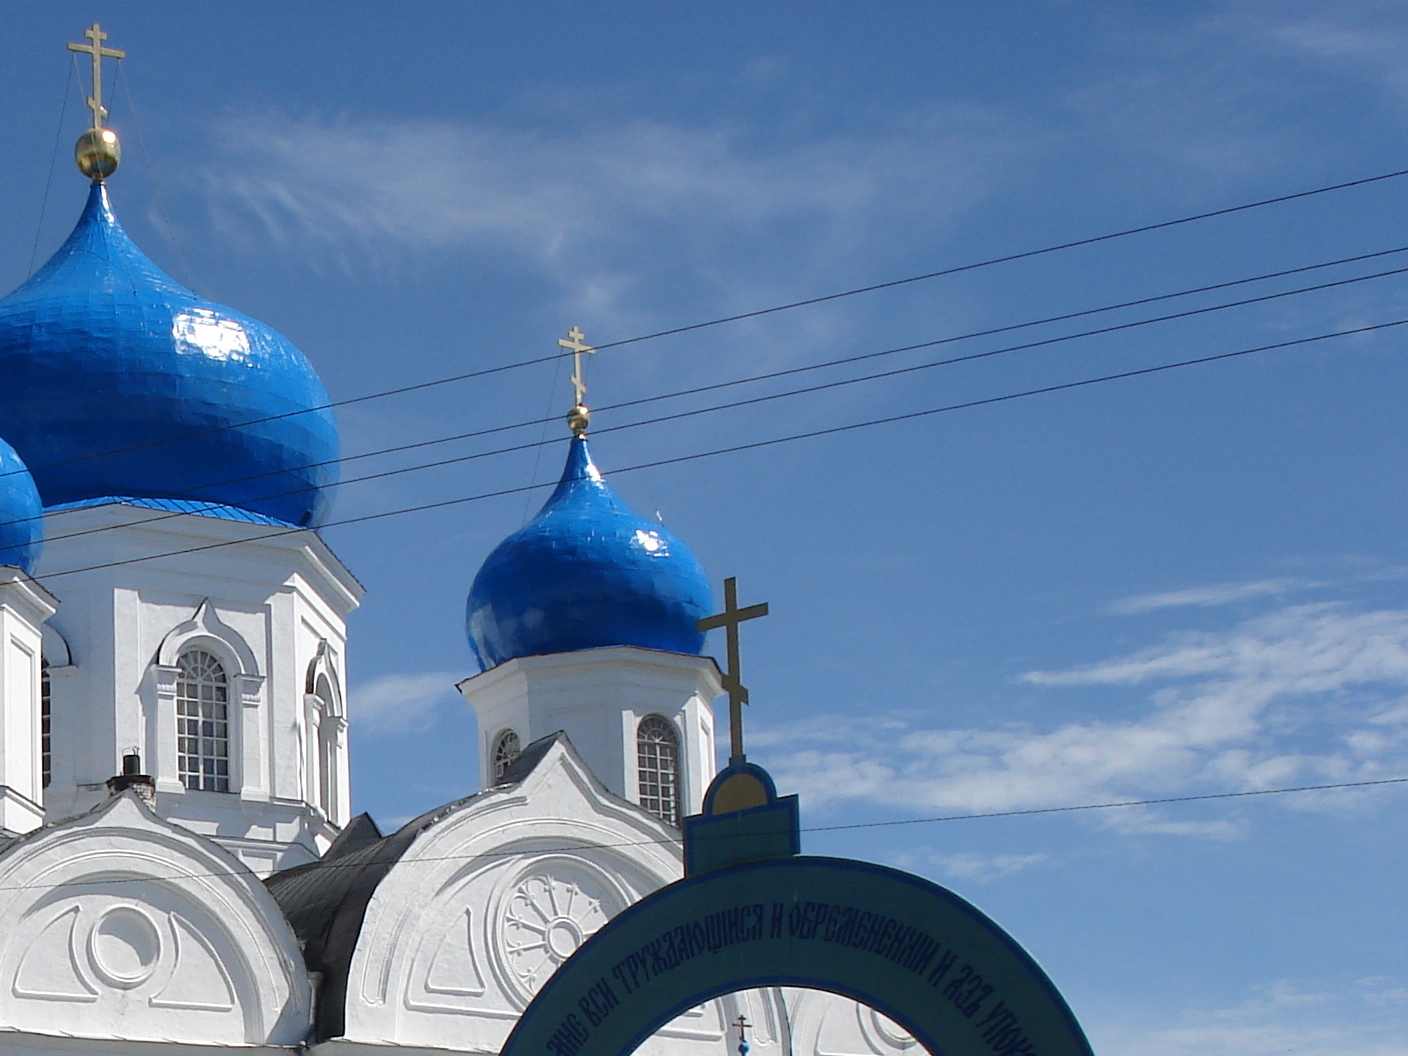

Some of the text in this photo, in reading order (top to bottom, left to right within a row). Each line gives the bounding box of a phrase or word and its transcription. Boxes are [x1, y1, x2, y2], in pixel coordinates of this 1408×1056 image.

[577, 977, 620, 1028] ВСИ
[770, 902, 785, 940] И
[932, 949, 955, 988] И
